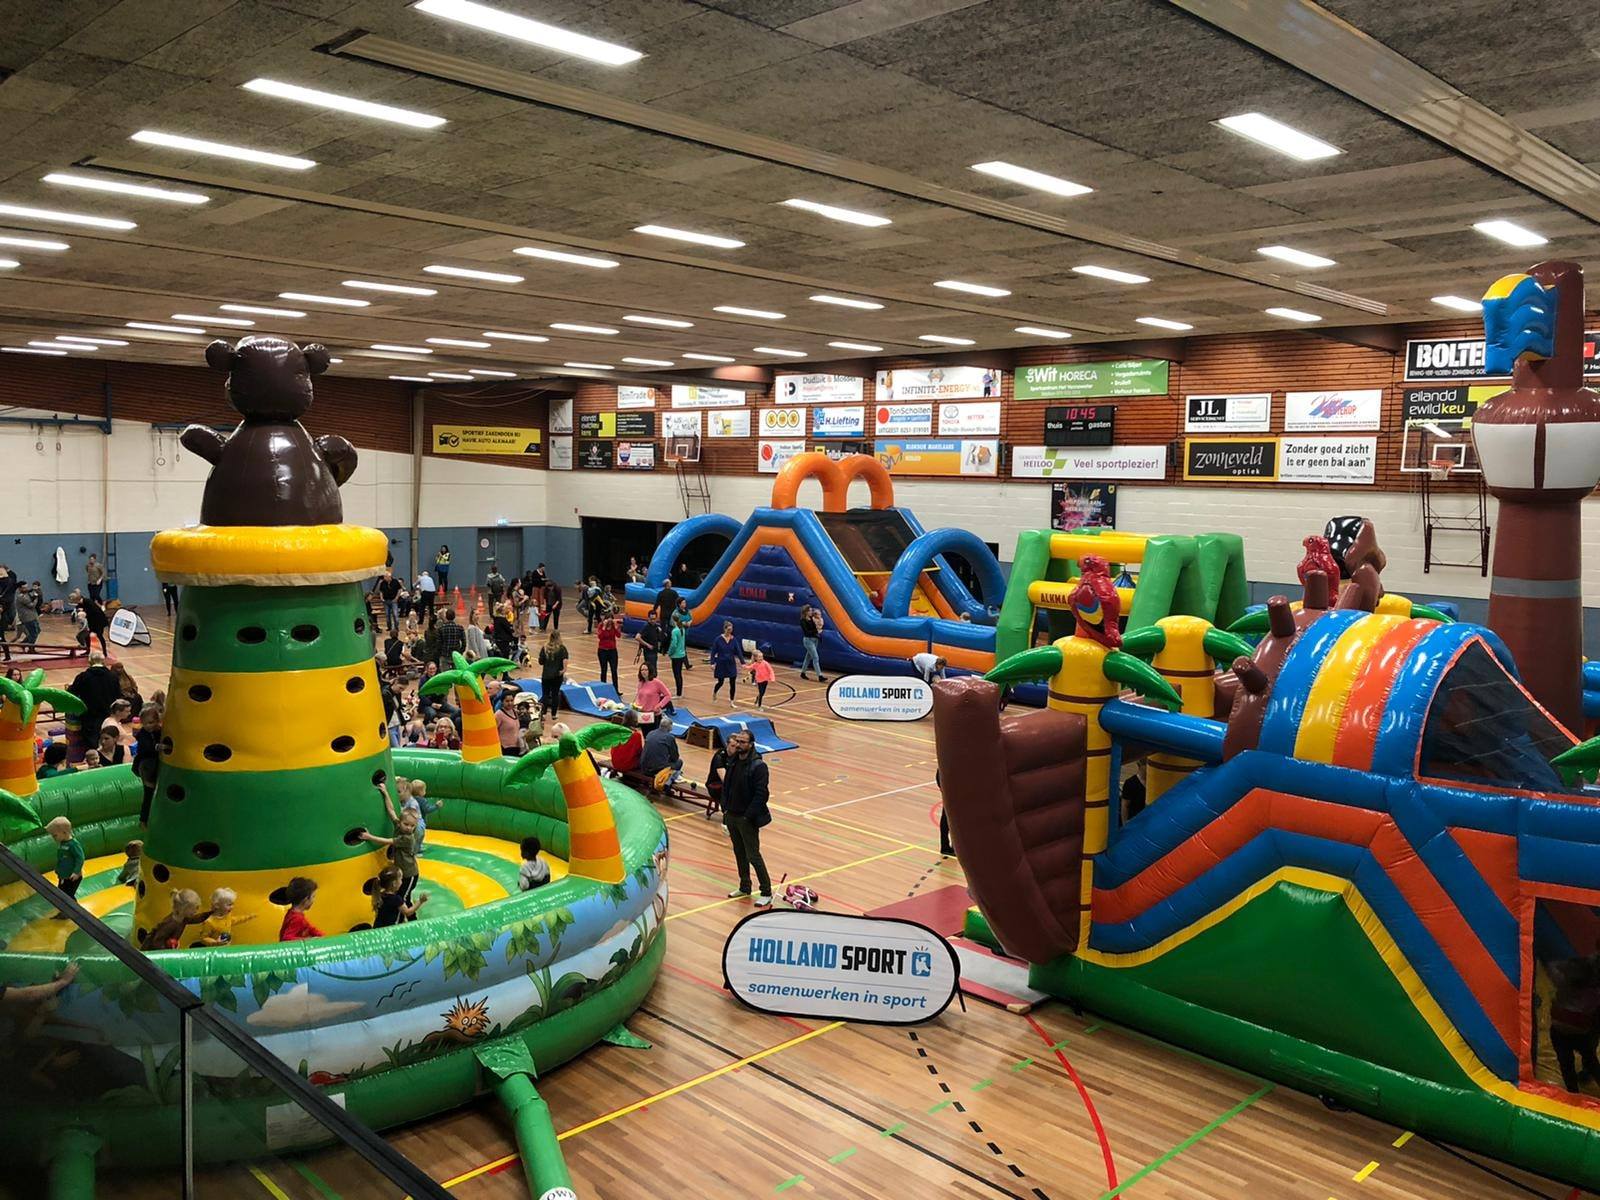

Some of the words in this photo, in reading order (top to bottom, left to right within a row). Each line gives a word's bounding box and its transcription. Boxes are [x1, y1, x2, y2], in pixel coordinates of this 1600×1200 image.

[1416, 342, 1486, 368] BOLTE
[1034, 367, 1057, 383] Wit
[1059, 371, 1097, 381] HORECA
[1410, 390, 1457, 402] eilandd
[1196, 400, 1219, 416] JL
[1409, 403, 1466, 415] ewildkeu
[1088, 421, 1112, 430] gasten
[1320, 444, 1343, 455] goed
[1345, 444, 1369, 454] zicht
[1073, 459, 1093, 468] Veel
[1096, 459, 1159, 470] sportplezier!
[1286, 457, 1294, 466] is
[1308, 459, 1329, 468] geen
[1331, 457, 1345, 467] bal
[839, 687, 880, 699] HOLLAND
[882, 688, 912, 699] SPORT
[749, 938, 838, 969] HOLLAND
[841, 945, 907, 975] SPORT
[748, 981, 859, 1002] samenwerken
[864, 991, 880, 1004] in
[882, 994, 927, 1009] sport
